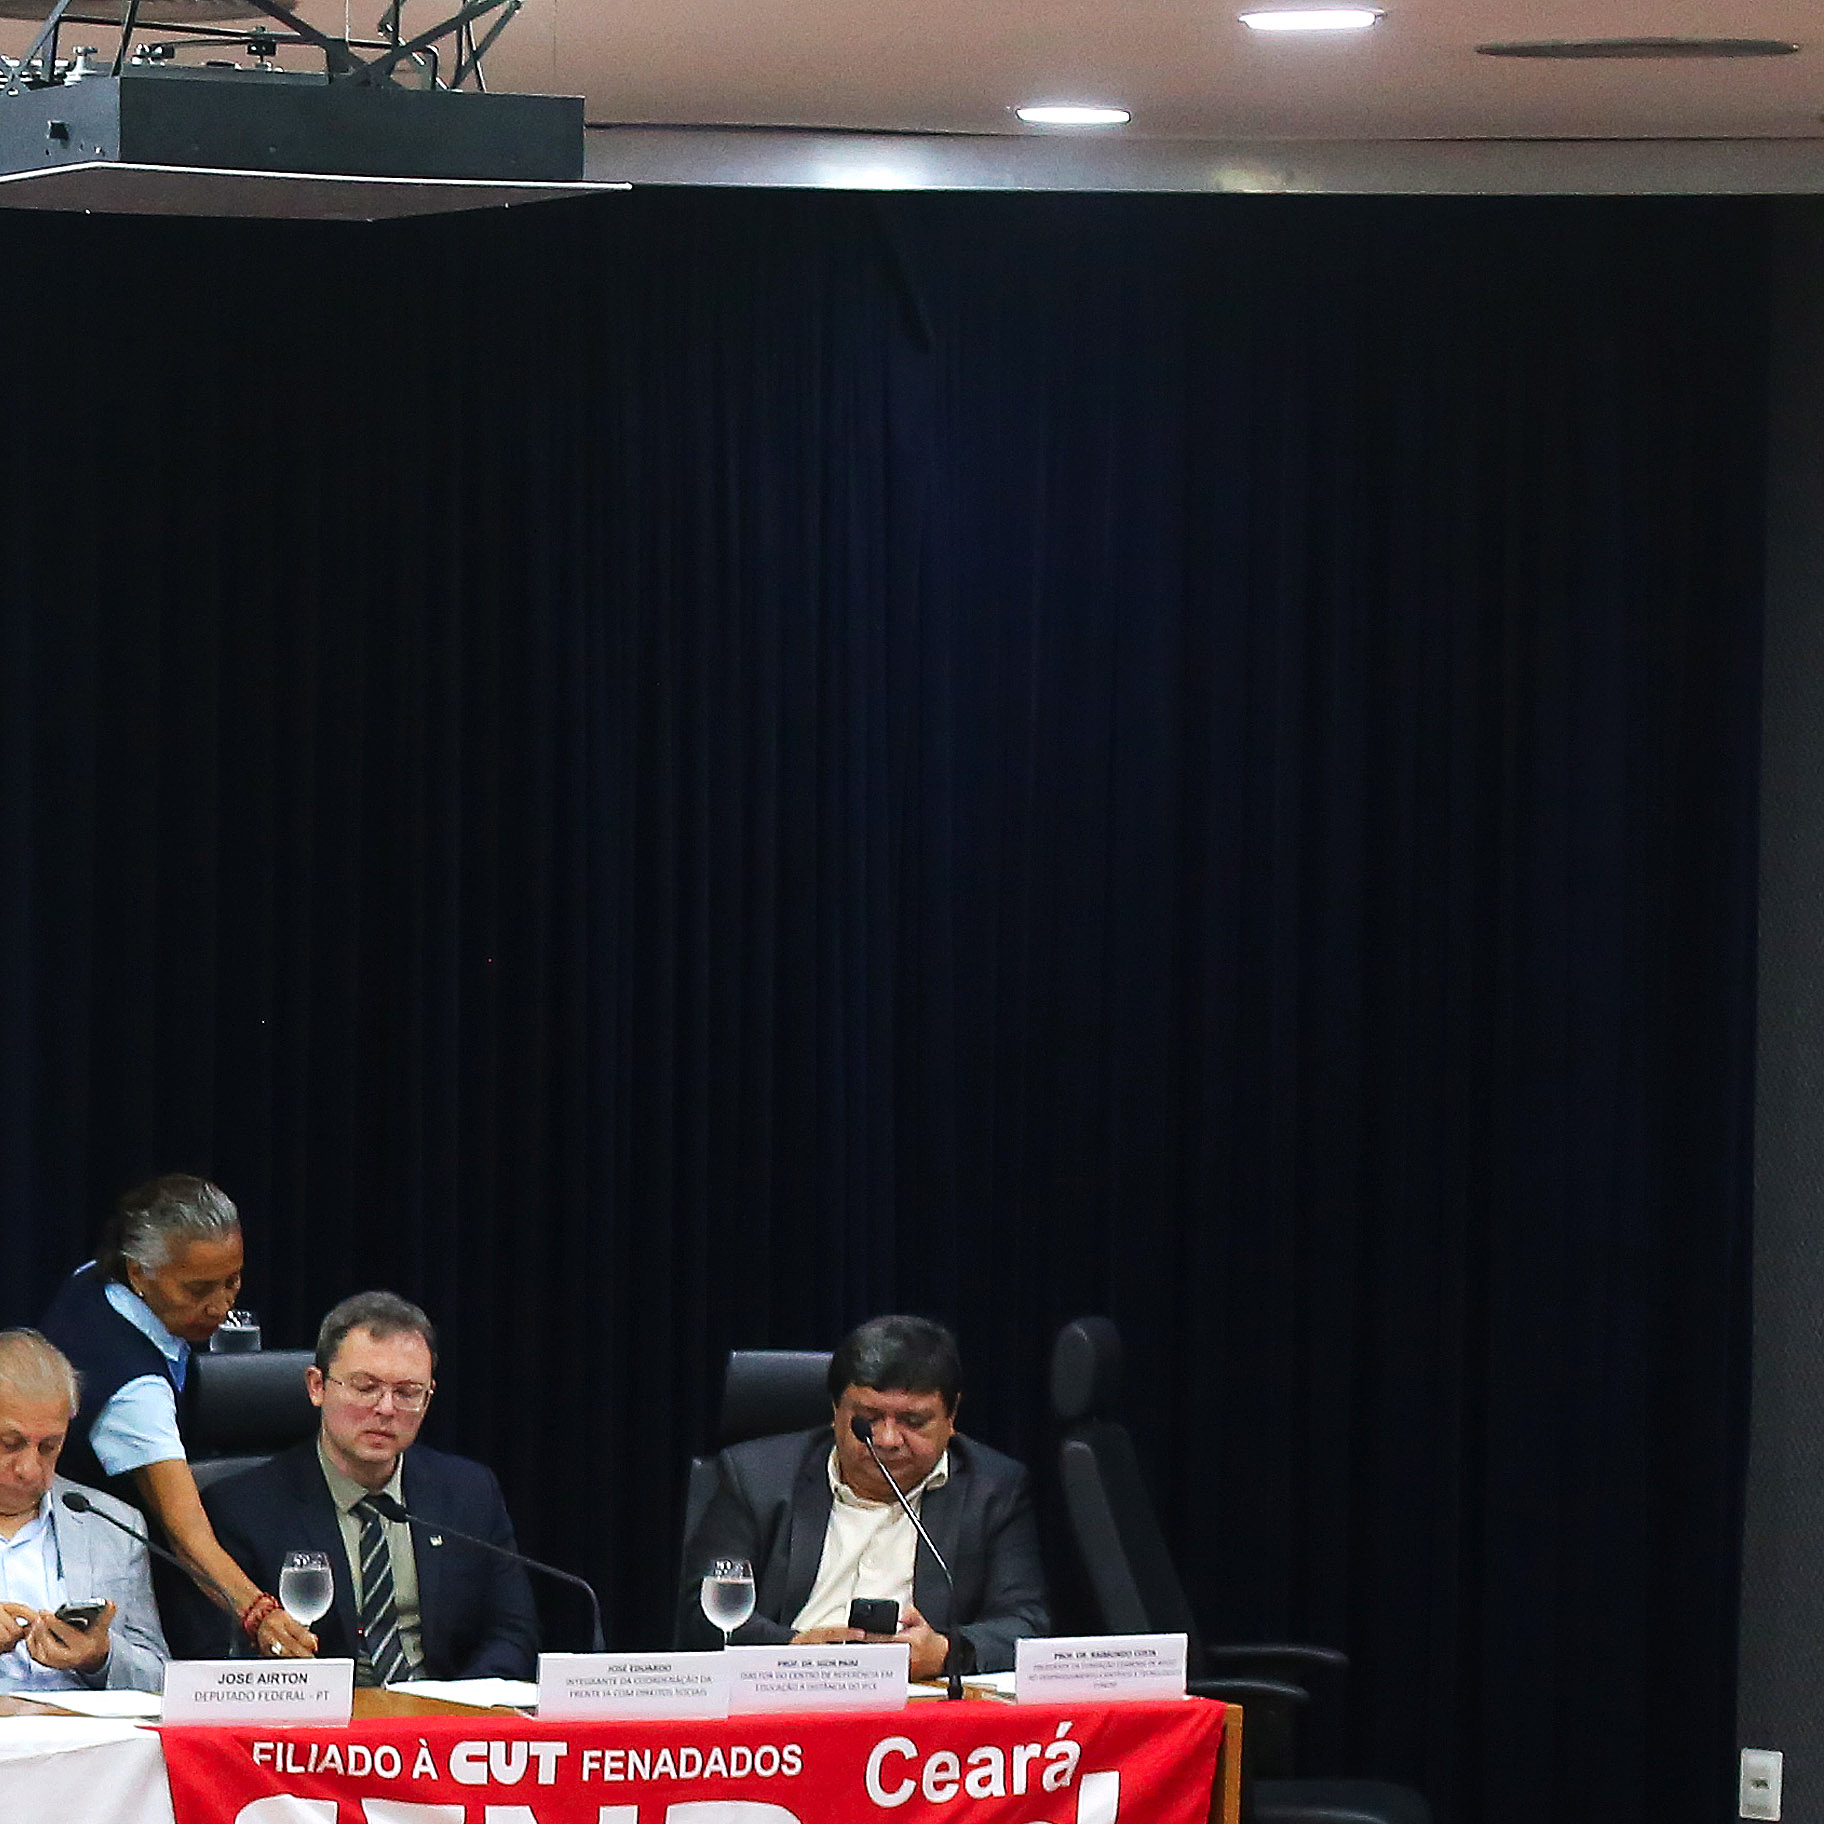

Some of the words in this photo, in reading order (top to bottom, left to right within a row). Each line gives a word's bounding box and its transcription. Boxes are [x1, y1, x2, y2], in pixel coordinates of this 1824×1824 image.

[256, 1673, 309, 1685] AIRTON
[194, 1691, 255, 1702] DEPUTADO
[258, 1690, 305, 1701] FEDERAL
[316, 1690, 330, 1701] PT
[252, 1741, 398, 1779] FILIADO
[411, 1737, 439, 1779] À
[452, 1740, 568, 1786] CUT
[581, 1743, 802, 1782] FENADADOS
[864, 1721, 1082, 1807] Ceará
